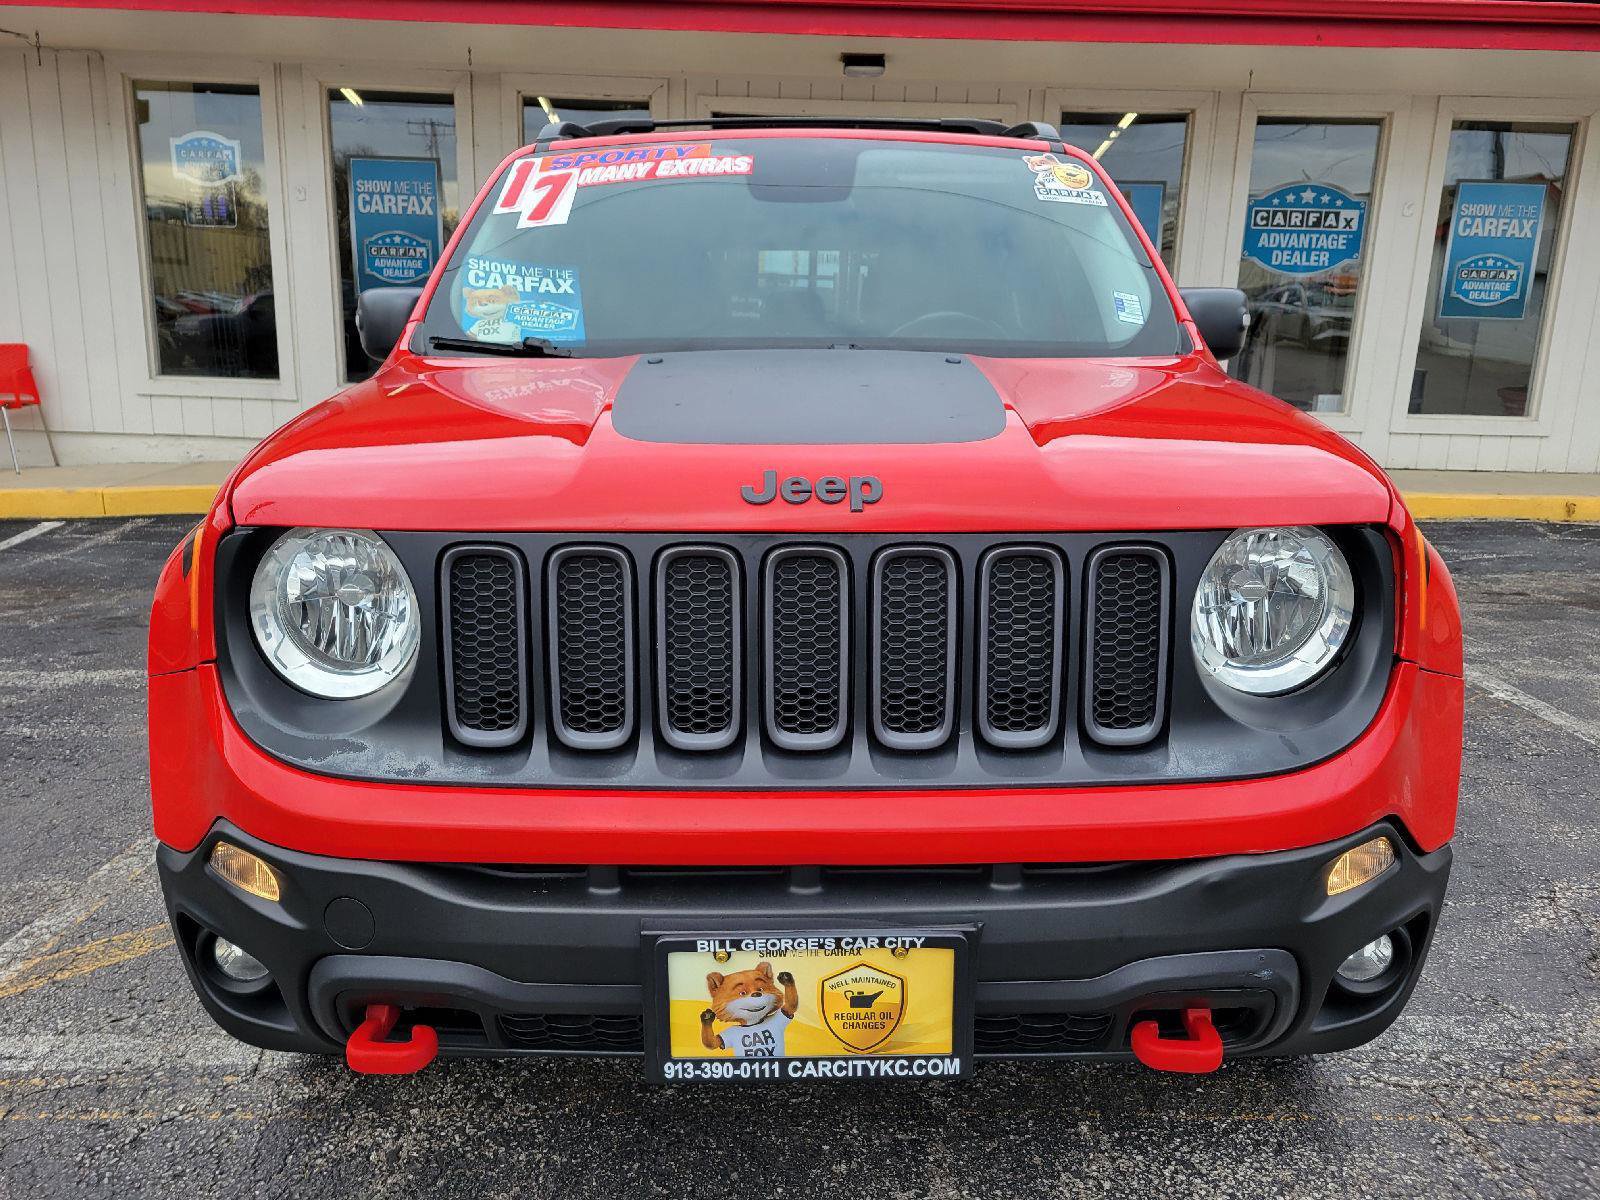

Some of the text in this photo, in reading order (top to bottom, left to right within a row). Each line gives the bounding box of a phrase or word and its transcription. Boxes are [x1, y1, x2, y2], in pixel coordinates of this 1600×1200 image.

[551, 145, 699, 170] SPORTY
[579, 156, 752, 186] MANY EXTRAS
[357, 179, 432, 195] SHOW ME THE
[499, 159, 574, 223] 17
[358, 193, 434, 216] CARFAX
[1461, 204, 1537, 218] SHOW ME THE
[1255, 210, 1355, 230] CARFAX
[1458, 217, 1535, 238] CARFAX
[1258, 233, 1347, 249] ADVANTAGE
[370, 247, 425, 258] CARFAX
[1271, 250, 1330, 266] DEALER
[374, 258, 423, 268] ADVANTAGE
[468, 258, 573, 279] SHOW ME THE
[383, 268, 415, 277] DEALER
[1461, 270, 1516, 280] CARFAX
[467, 269, 576, 294] CARFAX
[1462, 281, 1511, 291] ADVANTAGE
[1469, 292, 1501, 300] DEALER
[740, 470, 883, 512] Jeep
[696, 936, 926, 952] BILL GEORGE'S CAR CITY
[758, 949, 787, 958] SHOW
[824, 949, 862, 957] CARFAX
[829, 976, 896, 990] WELL MAINTAINED
[834, 1011, 894, 1020] REGULAR OIL
[842, 1021, 886, 1029] CHANGES
[741, 1029, 775, 1047] CAR
[664, 1058, 960, 1079] 913-390-0111 CARCITYKC.COM
